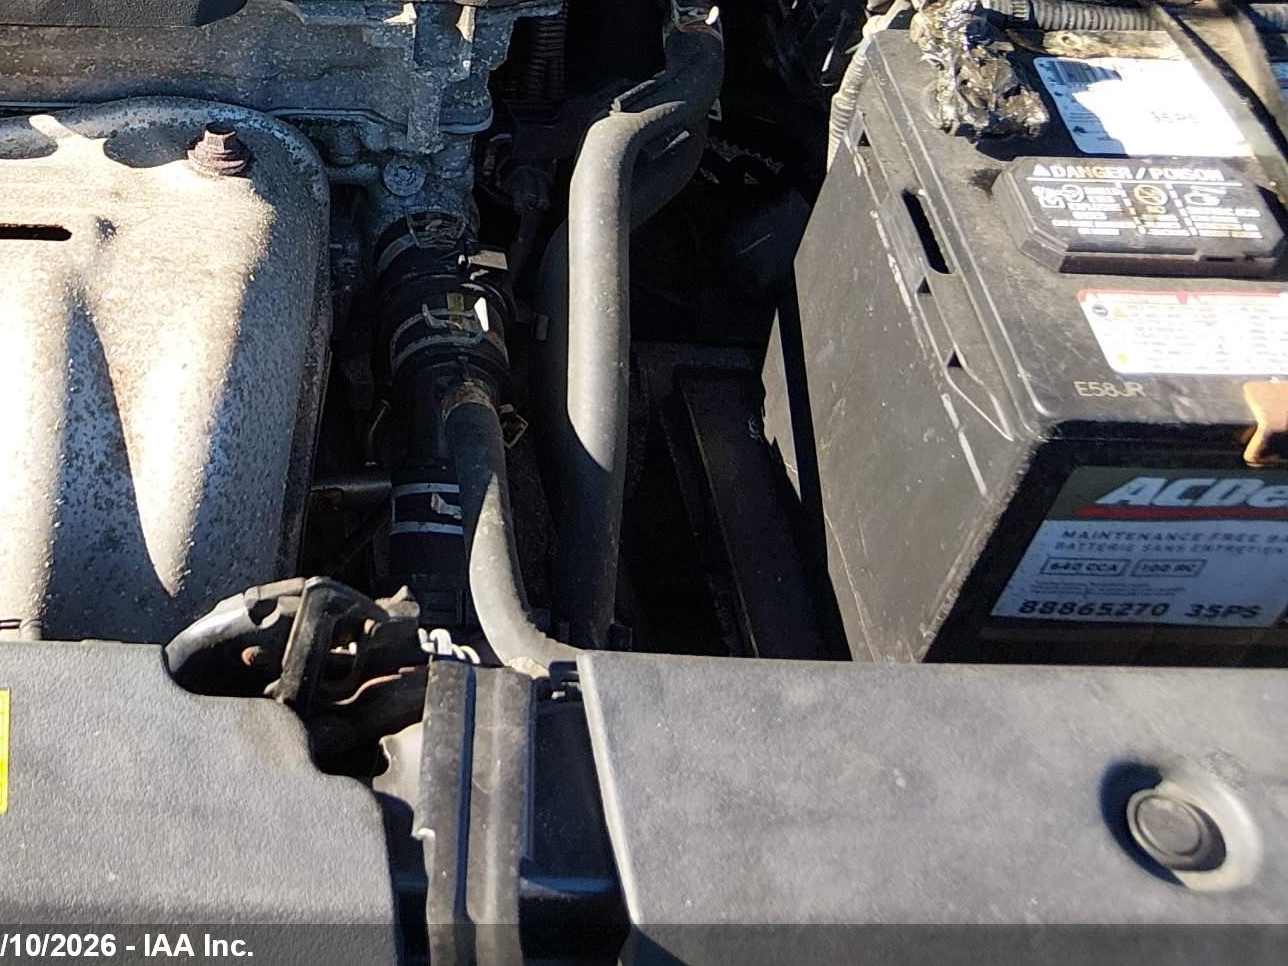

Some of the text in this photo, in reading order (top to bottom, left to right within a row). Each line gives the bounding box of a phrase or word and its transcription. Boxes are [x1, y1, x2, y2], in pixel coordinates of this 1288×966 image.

[1050, 166, 1132, 179] DANGER
[1149, 168, 1224, 181] POISON
[1073, 381, 1147, 398] E58JR
[1062, 530, 1203, 542] MAINTENANCE
[1210, 532, 1260, 543] FREE
[1054, 541, 1283, 554] BATTERIE SANS ENTRETIEN
[1086, 562, 1117, 572] CCA
[1018, 600, 1262, 618] 88865270 35PS
